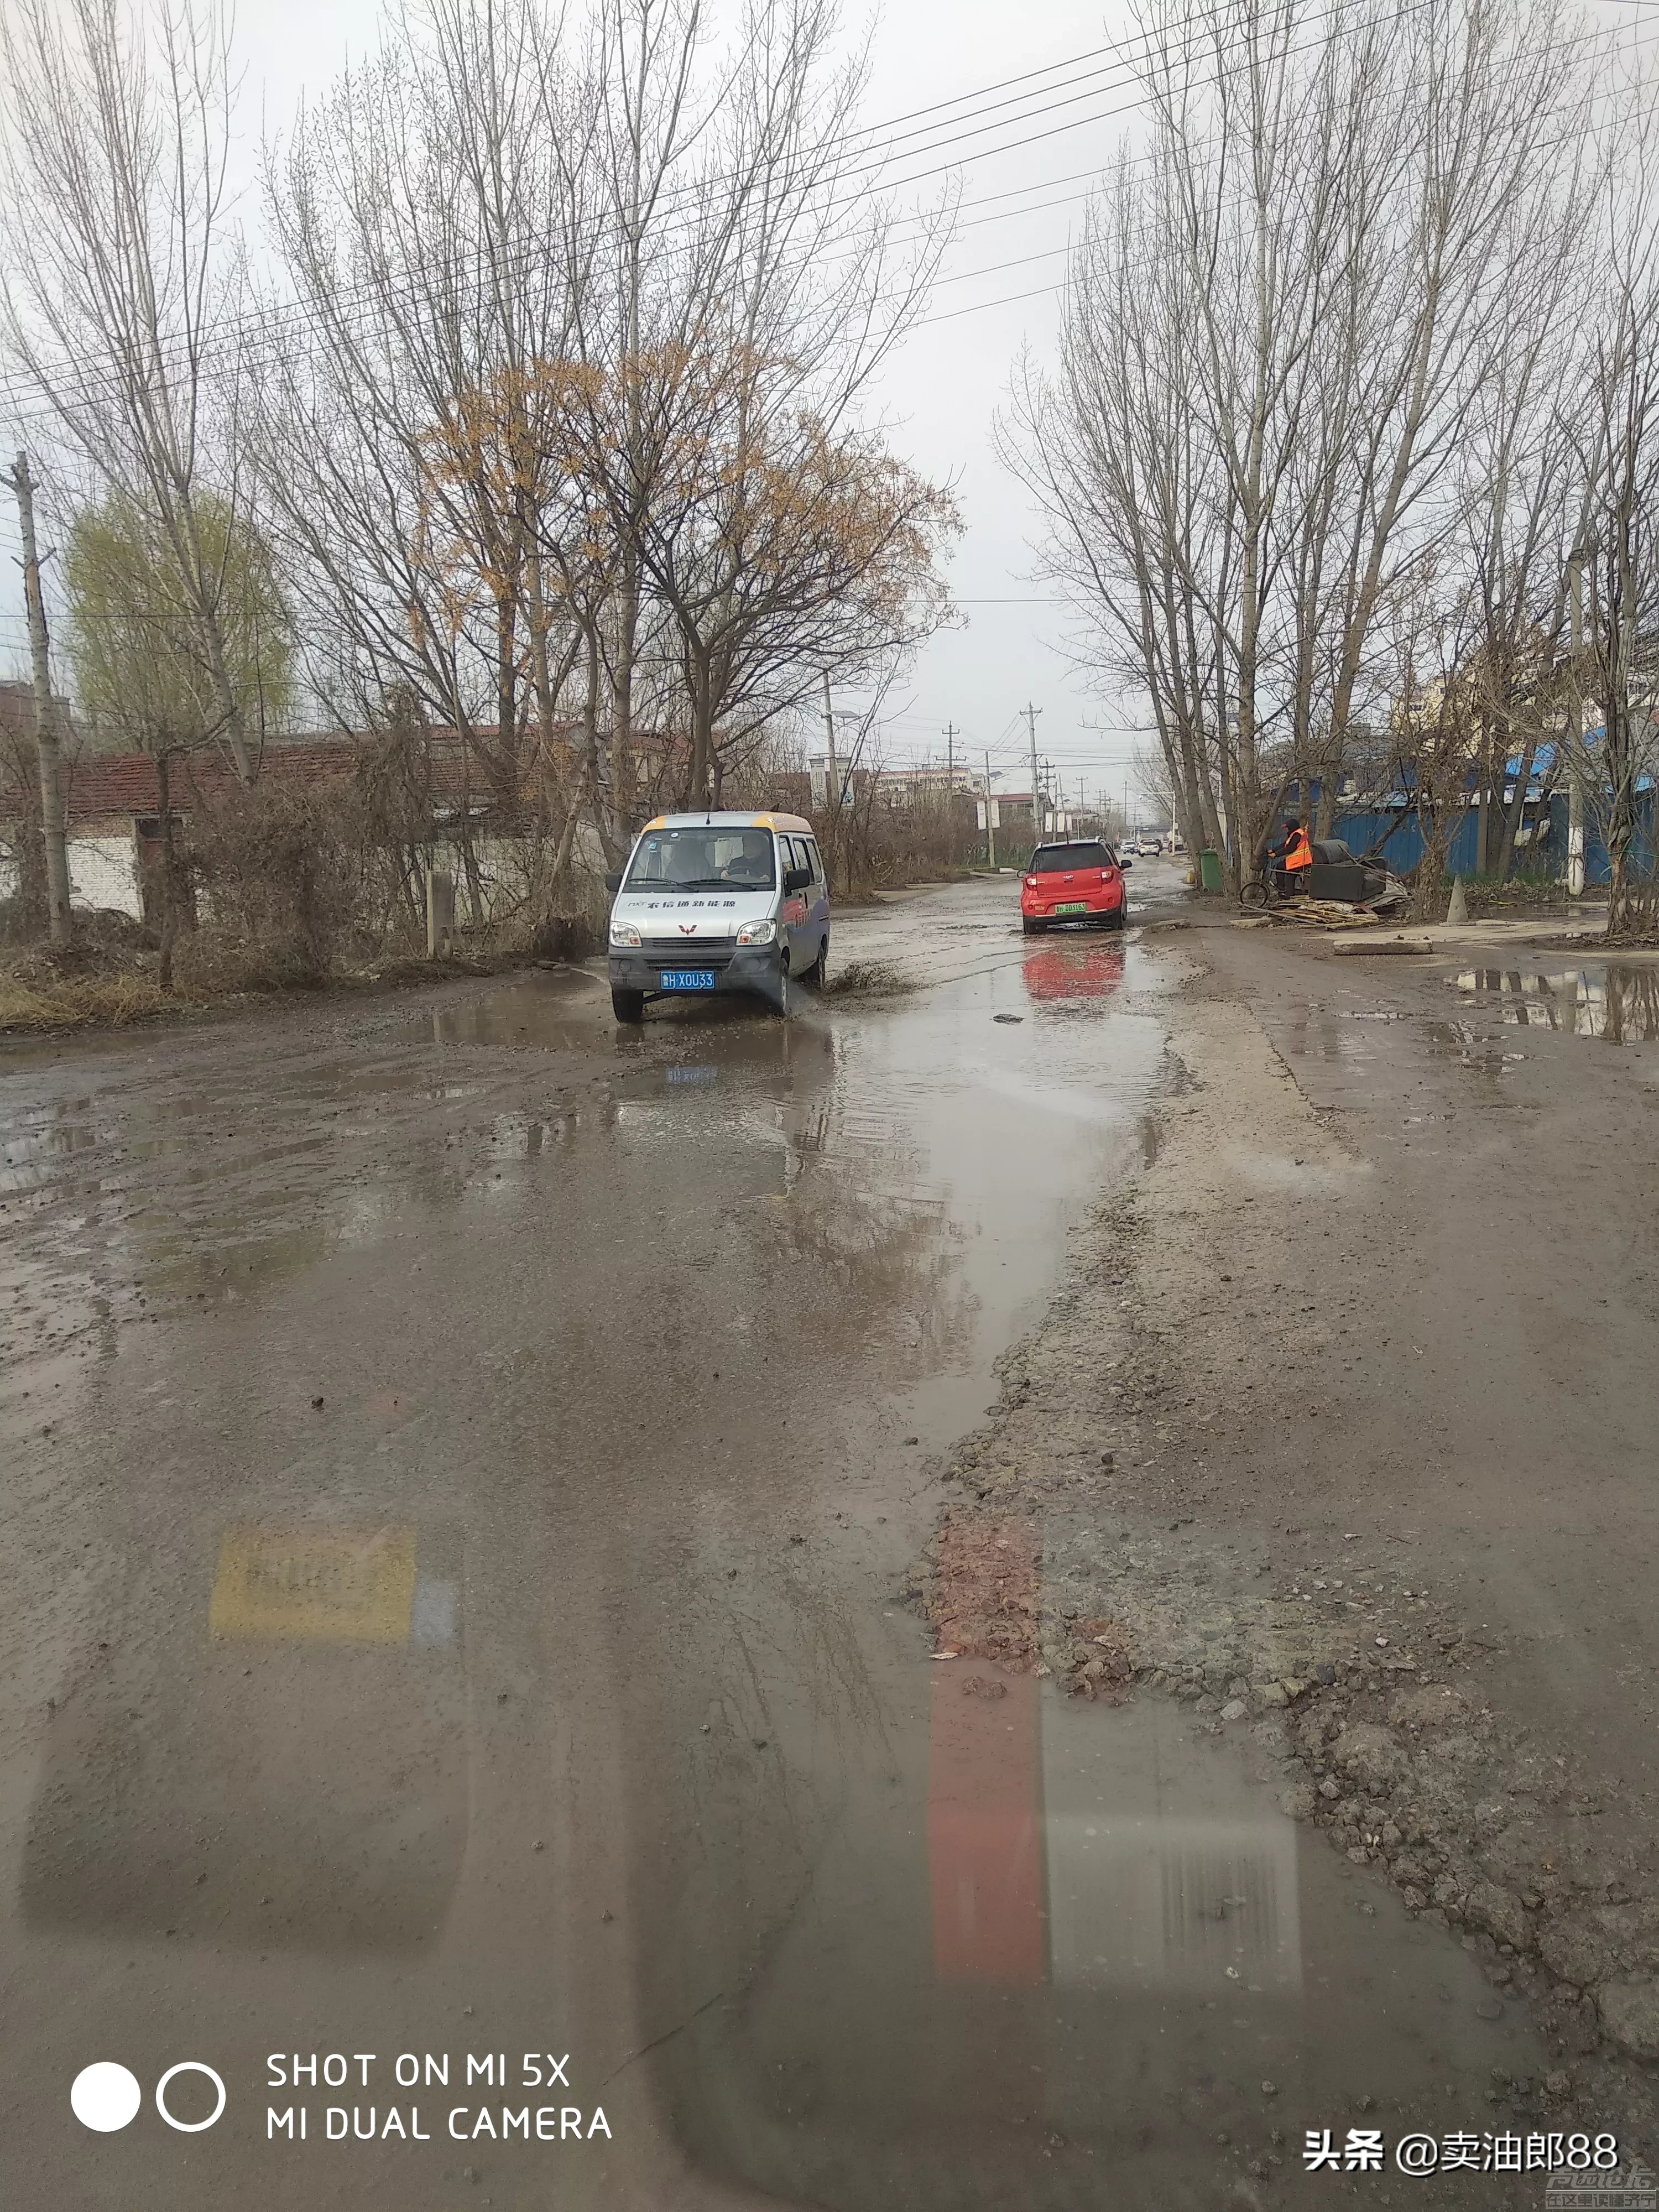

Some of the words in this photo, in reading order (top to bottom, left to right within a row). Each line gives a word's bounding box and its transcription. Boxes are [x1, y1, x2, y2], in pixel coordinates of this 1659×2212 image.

[647, 900, 735, 909] 农信通新能源
